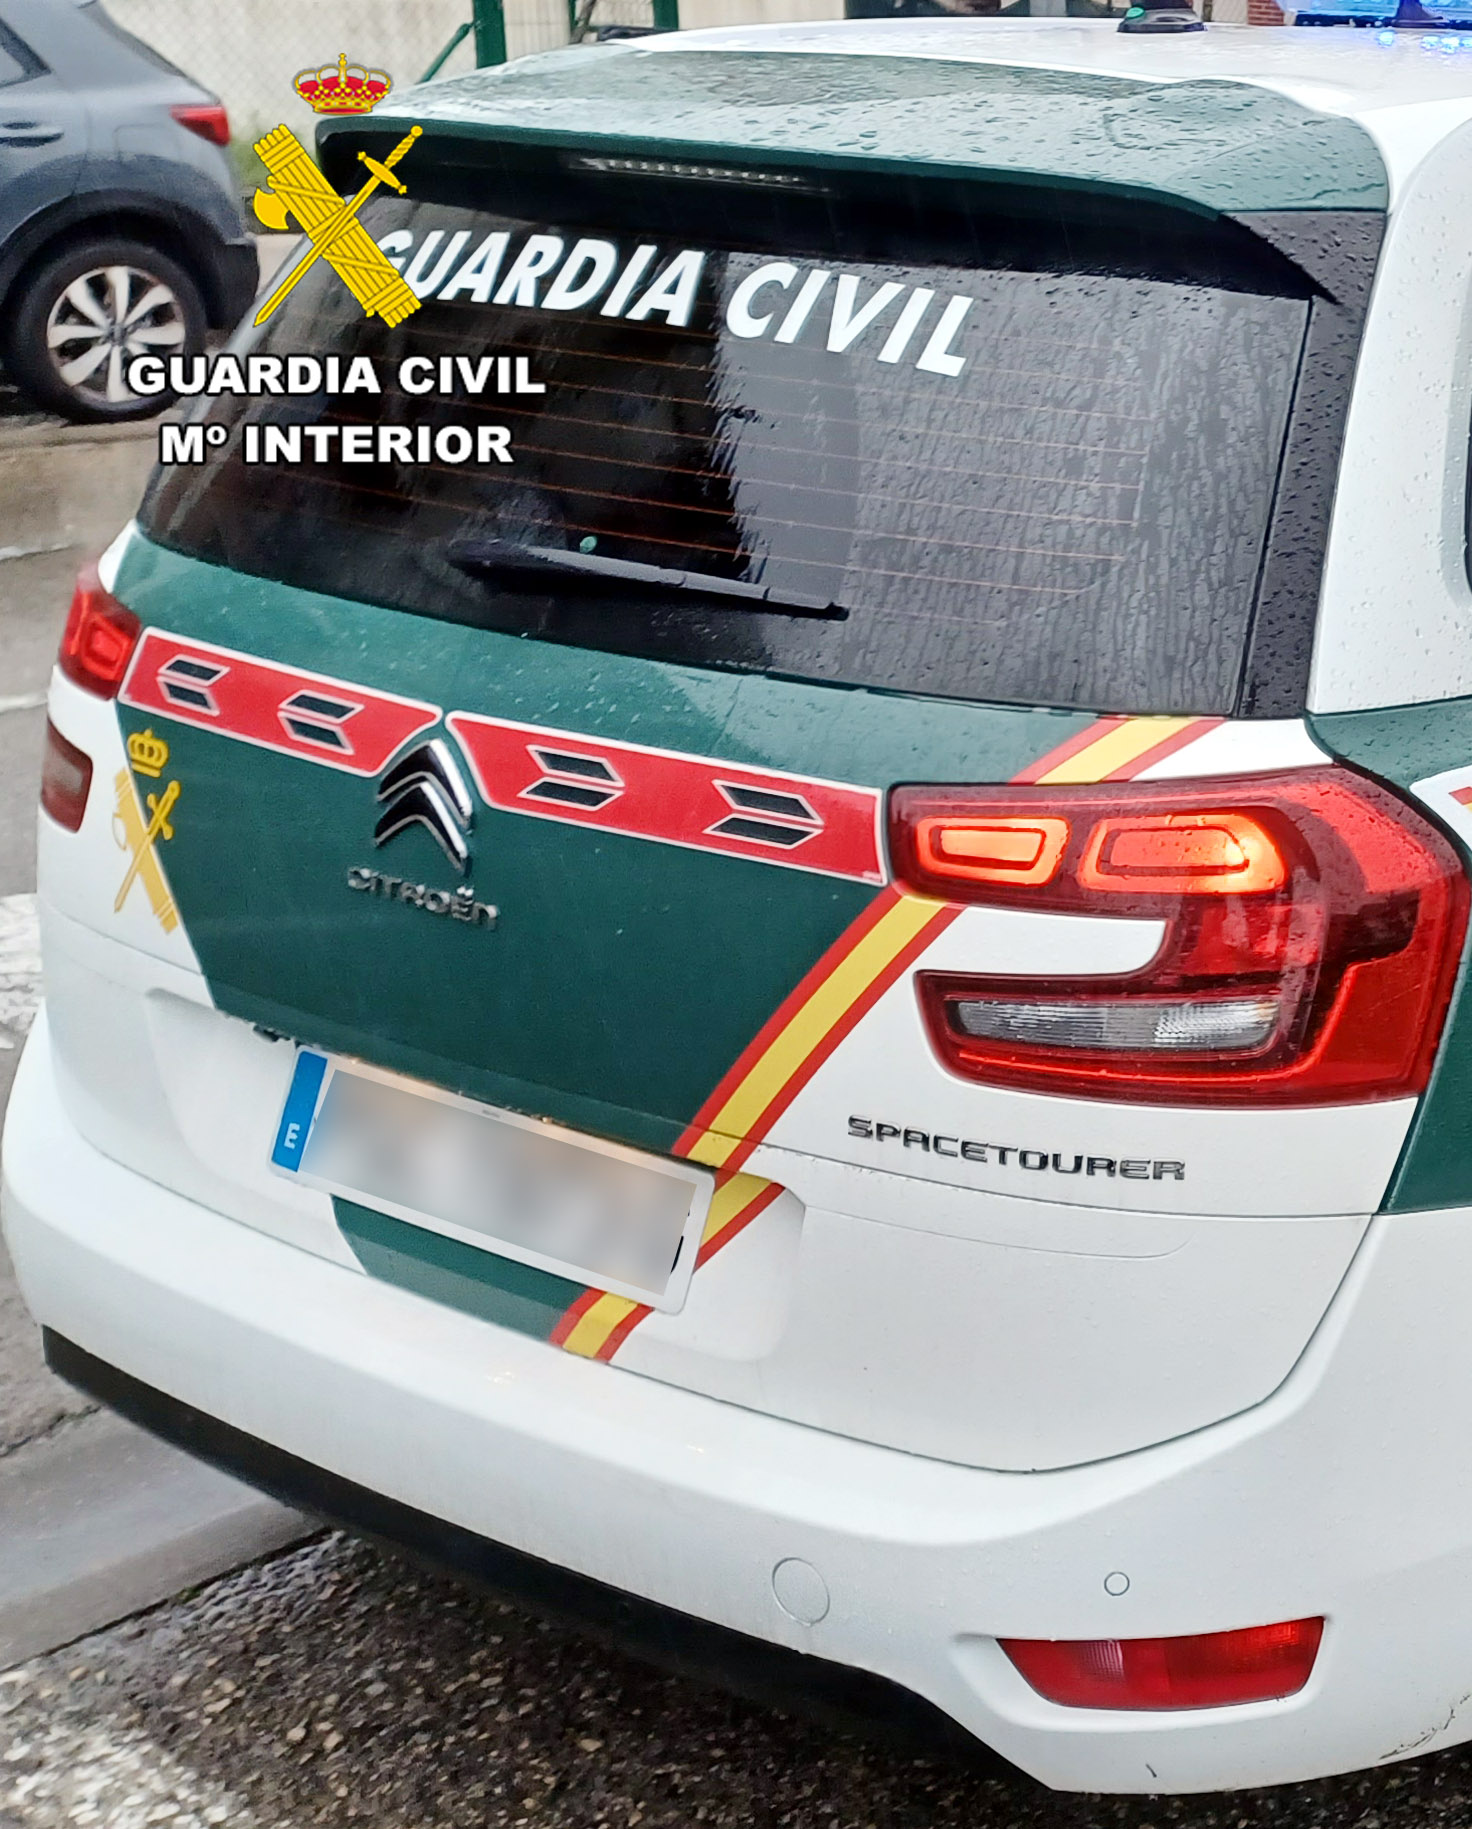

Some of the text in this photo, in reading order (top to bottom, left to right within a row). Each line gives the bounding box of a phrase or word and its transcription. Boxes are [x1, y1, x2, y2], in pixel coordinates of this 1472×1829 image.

[726, 262, 974, 377] CIVIL
[283, 1122, 300, 1149] E
[848, 1114, 1186, 1180] SPACETOURER
